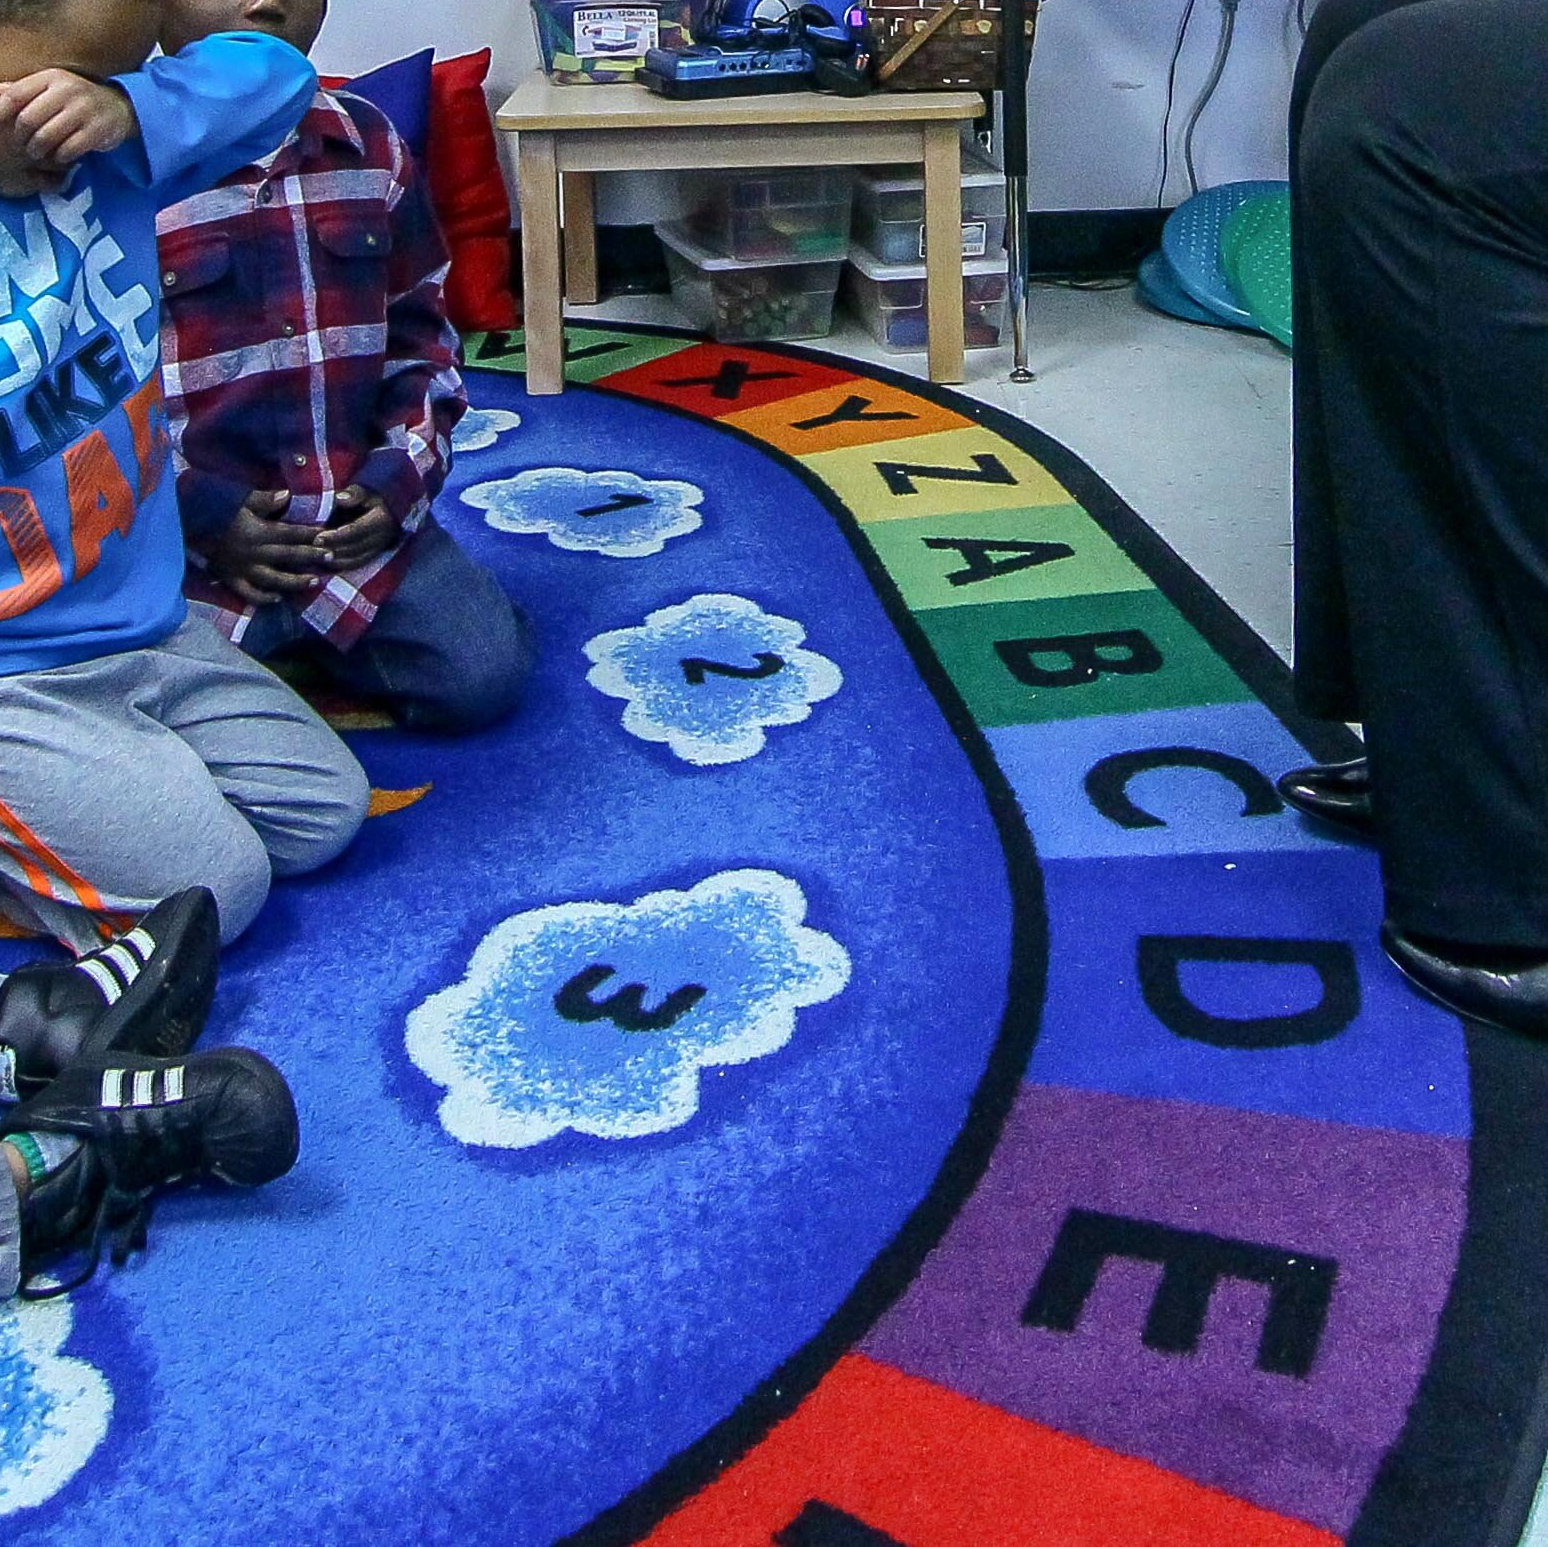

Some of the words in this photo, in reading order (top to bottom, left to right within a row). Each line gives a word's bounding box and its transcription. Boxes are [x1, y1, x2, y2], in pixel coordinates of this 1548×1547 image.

[577, 11, 614, 22] BELLA
[655, 358, 802, 400] X
[792, 394, 919, 433] Y
[874, 452, 1021, 506] Z
[922, 534, 1077, 587] A
[681, 650, 785, 686] 2
[991, 628, 1166, 691] B
[1083, 746, 1288, 832] C
[553, 963, 709, 1034] 3
[1135, 935, 1363, 1051] D
[1019, 1207, 1341, 1382] E
